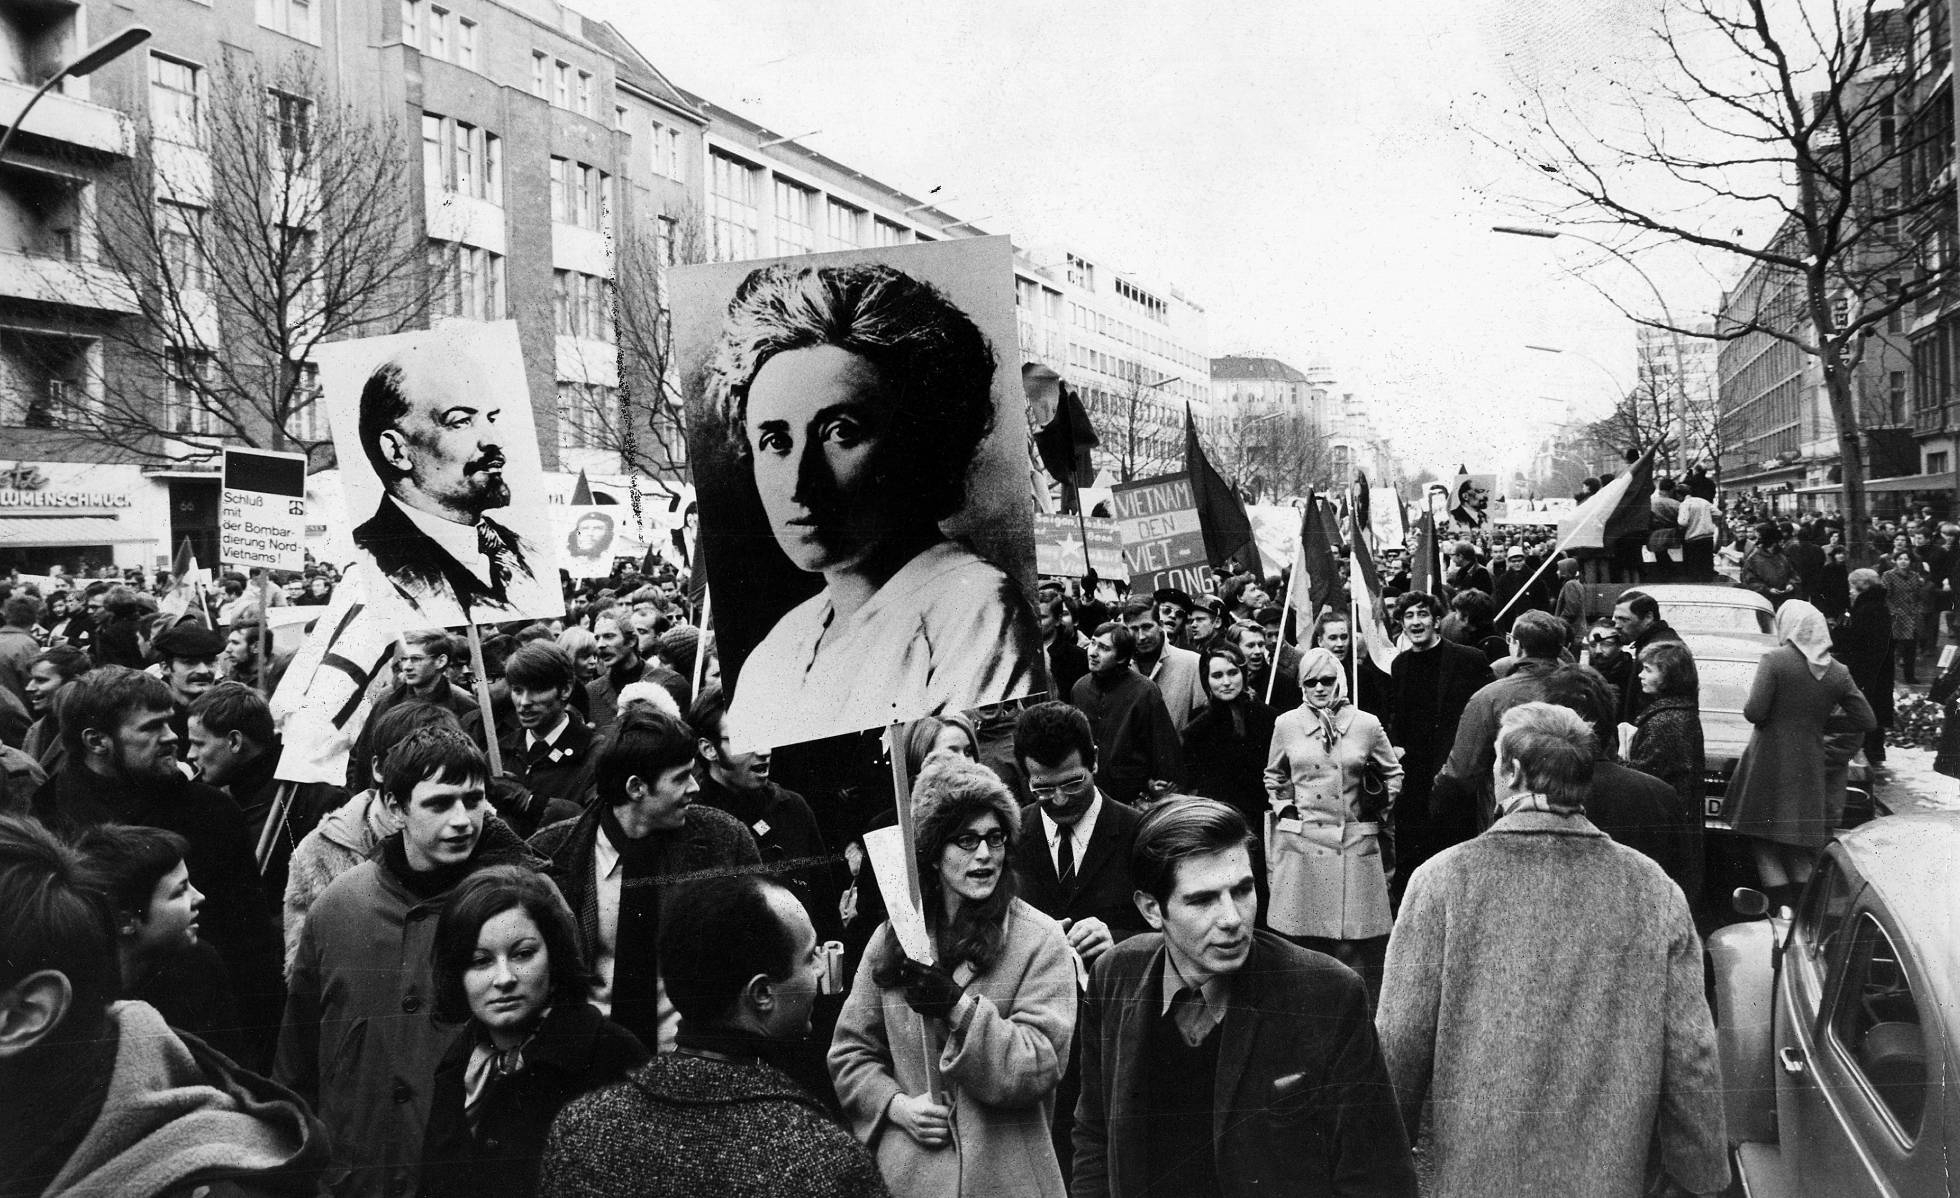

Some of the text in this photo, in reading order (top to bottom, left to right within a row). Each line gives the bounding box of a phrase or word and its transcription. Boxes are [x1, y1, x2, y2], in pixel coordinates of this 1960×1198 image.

[0, 492, 132, 507] LUMENSCHMUCK
[224, 491, 263, 507] Schluß
[1115, 482, 1191, 518] VIETNAM
[223, 507, 242, 518] mit
[223, 521, 241, 531] der
[245, 522, 295, 537] Bombar-
[1137, 515, 1176, 539] DEN
[222, 535, 302, 552] dierung Nord-
[222, 546, 282, 564] Vietnams!
[1153, 565, 1215, 596] CONG
